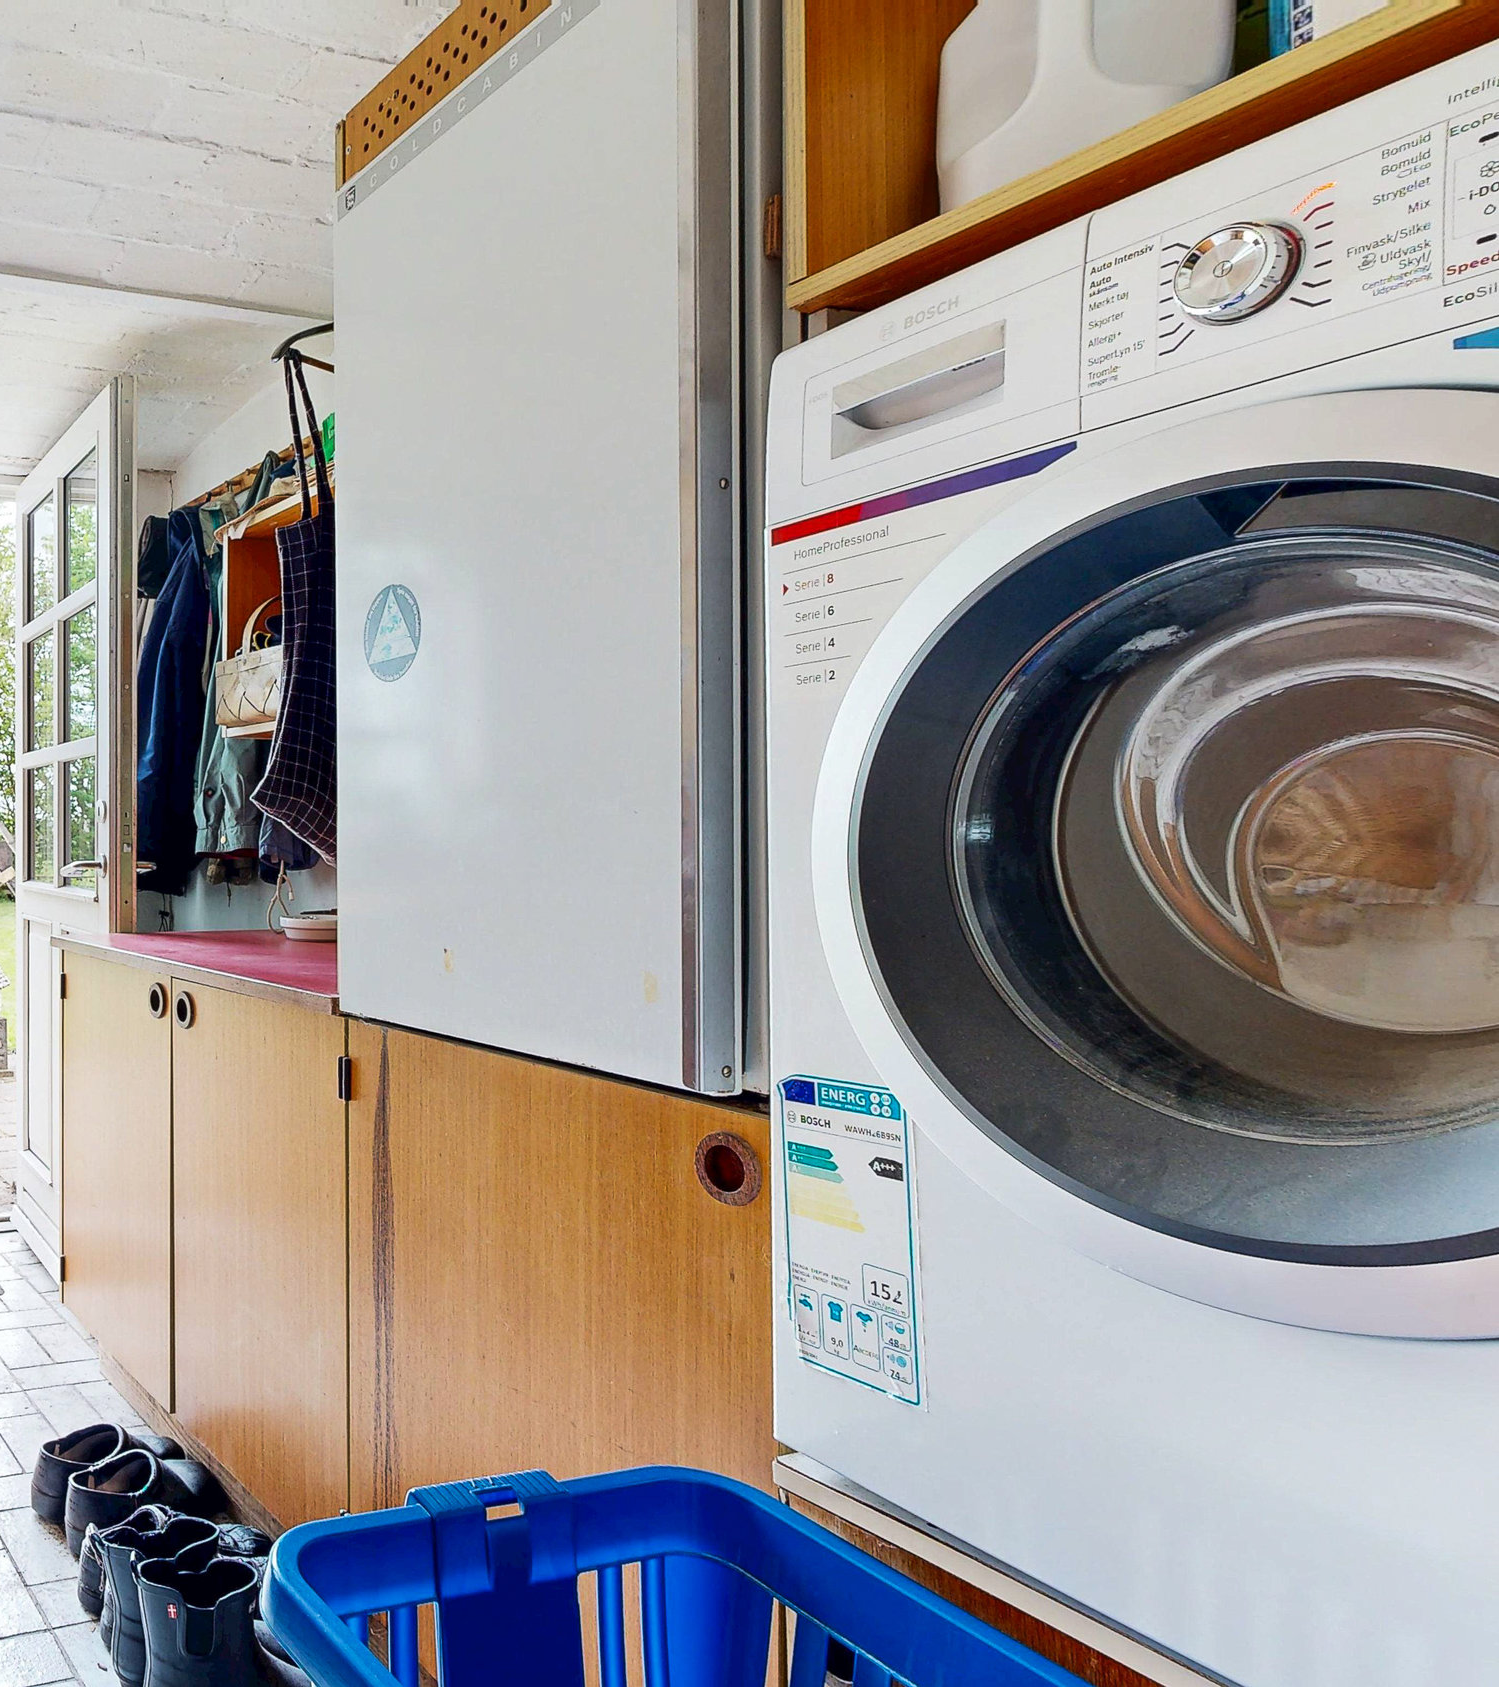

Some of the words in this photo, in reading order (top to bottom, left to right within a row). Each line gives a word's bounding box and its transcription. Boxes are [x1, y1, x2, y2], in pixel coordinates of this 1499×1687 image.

[1380, 149, 1431, 176] Bomuld
[1372, 177, 1431, 206] Strygelet
[1408, 200, 1431, 215] Mix
[1090, 261, 1113, 276] Auto
[1114, 244, 1155, 266] Intensiv
[1380, 240, 1432, 264] Uldvask
[1398, 250, 1432, 271] Skyl/
[1089, 275, 1112, 289] Auto
[903, 296, 960, 330] BOSCH
[1088, 311, 1125, 330] Skjorter
[1087, 346, 1131, 367] SuperLyn
[793, 525, 890, 561] HomeProfessional
[794, 579, 820, 592] Serie
[795, 609, 821, 623] Serie
[795, 640, 822, 654] Serie
[796, 672, 822, 686] Serie
[821, 1087, 866, 1106] ENERG
[800, 1114, 831, 1129] BOSCH
[830, 1337, 844, 1348] 9,0
